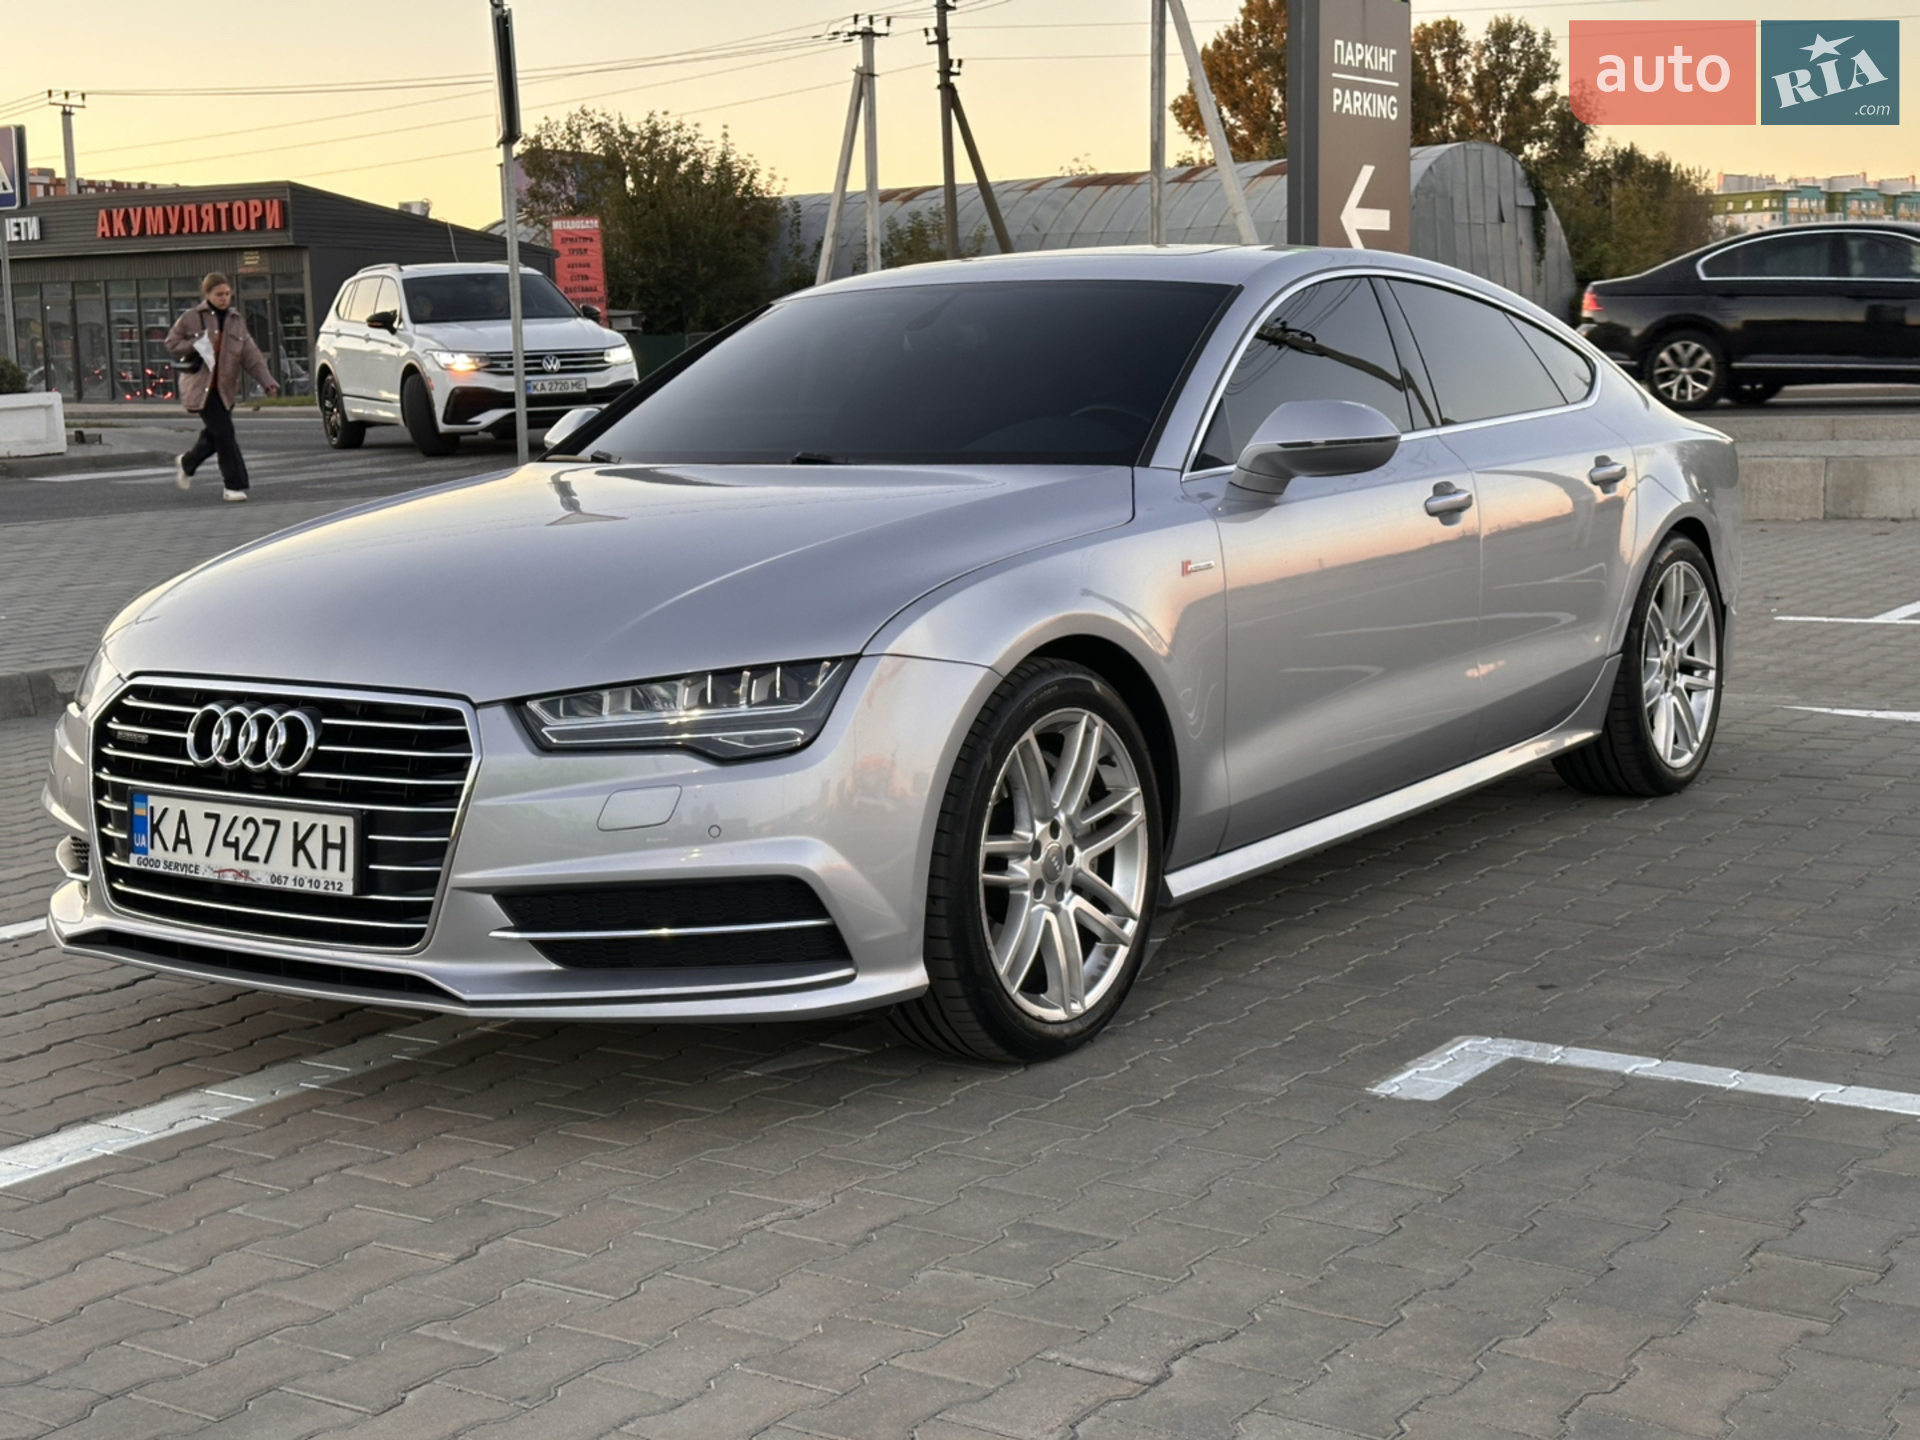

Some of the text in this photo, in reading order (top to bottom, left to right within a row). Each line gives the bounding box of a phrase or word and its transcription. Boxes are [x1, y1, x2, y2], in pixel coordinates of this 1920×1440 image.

[1333, 39, 1397, 73] ПАРКІНГ
[1332, 87, 1398, 120] PARKING
[96, 199, 284, 239] АКУМУЛЯТОРИ
[532, 381, 584, 392] KA 2720 ME
[134, 832, 147, 848] UA
[149, 805, 346, 873] KA 7427 KH
[136, 856, 200, 875] GOOD SERVICE
[270, 873, 344, 892] 067 10 10 212
